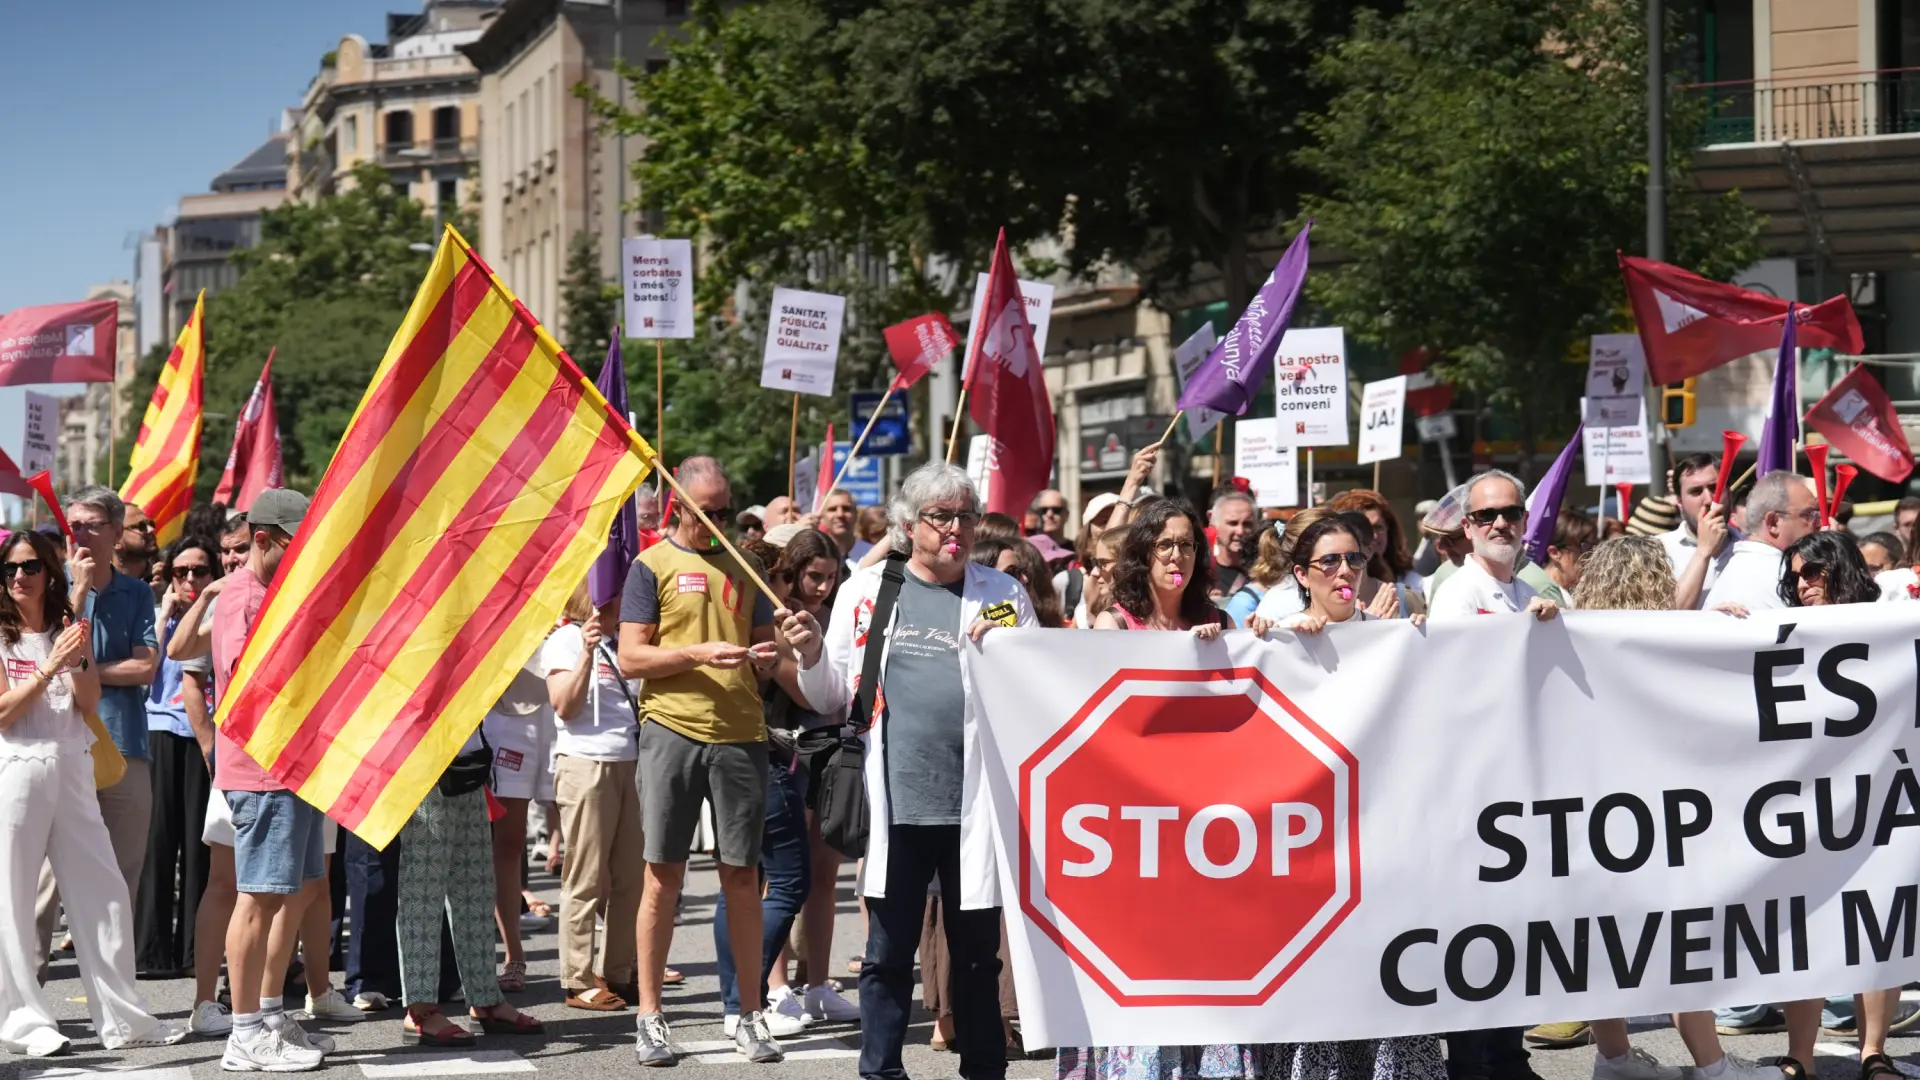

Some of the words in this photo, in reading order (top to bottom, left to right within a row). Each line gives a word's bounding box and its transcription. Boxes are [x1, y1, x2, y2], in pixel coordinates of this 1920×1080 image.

[632, 255, 669, 265] Menys
[633, 268, 682, 277] corbates
[640, 281, 664, 289] més
[634, 293, 668, 301] bates!
[781, 305, 827, 320] SANITAT,
[780, 315, 826, 330] PÚBLICA
[785, 328, 800, 337] DE
[777, 338, 829, 352] QUALITAT
[1279, 356, 1294, 366] La
[1298, 354, 1340, 364] nostra
[1281, 385, 1292, 396] el
[1296, 384, 1337, 395] nostre
[1281, 398, 1331, 410] conveni
[1367, 407, 1395, 430] JA!
[892, 624, 920, 640] Napa
[924, 627, 958, 648] Valley
[1753, 623, 1877, 742] ÉS
[1061, 802, 1323, 879] STOP
[1477, 788, 1713, 883] STOP
[1379, 895, 1810, 1007] CONVENI
